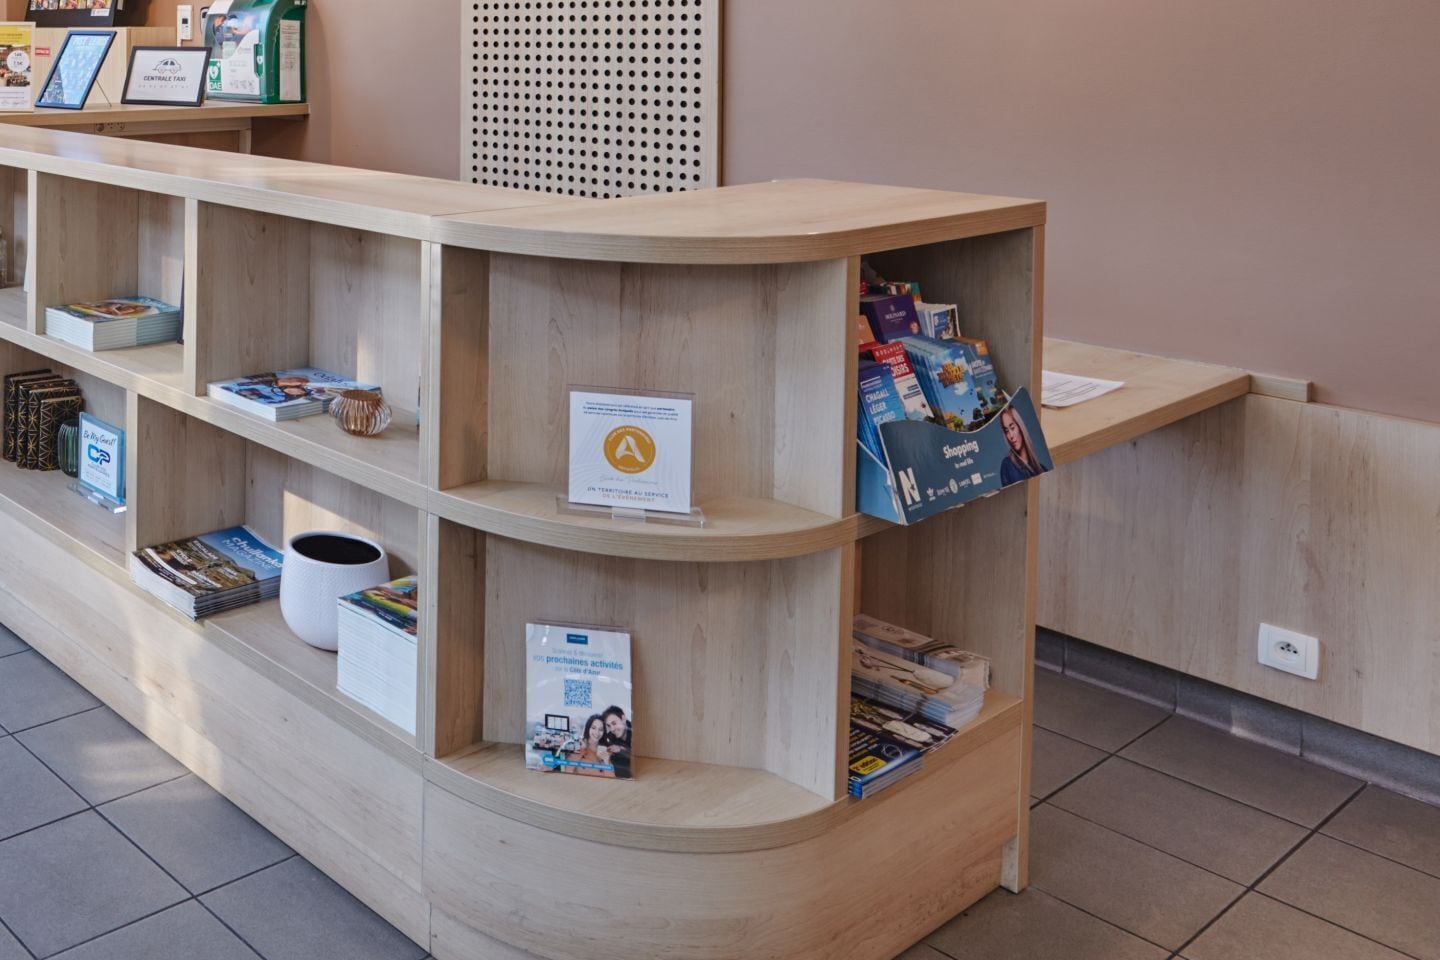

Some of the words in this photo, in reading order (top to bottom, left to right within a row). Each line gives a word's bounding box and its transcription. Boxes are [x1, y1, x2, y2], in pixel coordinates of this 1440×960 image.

[865, 387, 890, 403] CHAGALL
[942, 440, 980, 459] Shopping
[598, 487, 632, 496] TERRITOIRE
[644, 491, 669, 499] SERVICE
[546, 655, 589, 667] prochaines
[590, 659, 624, 671] activités
